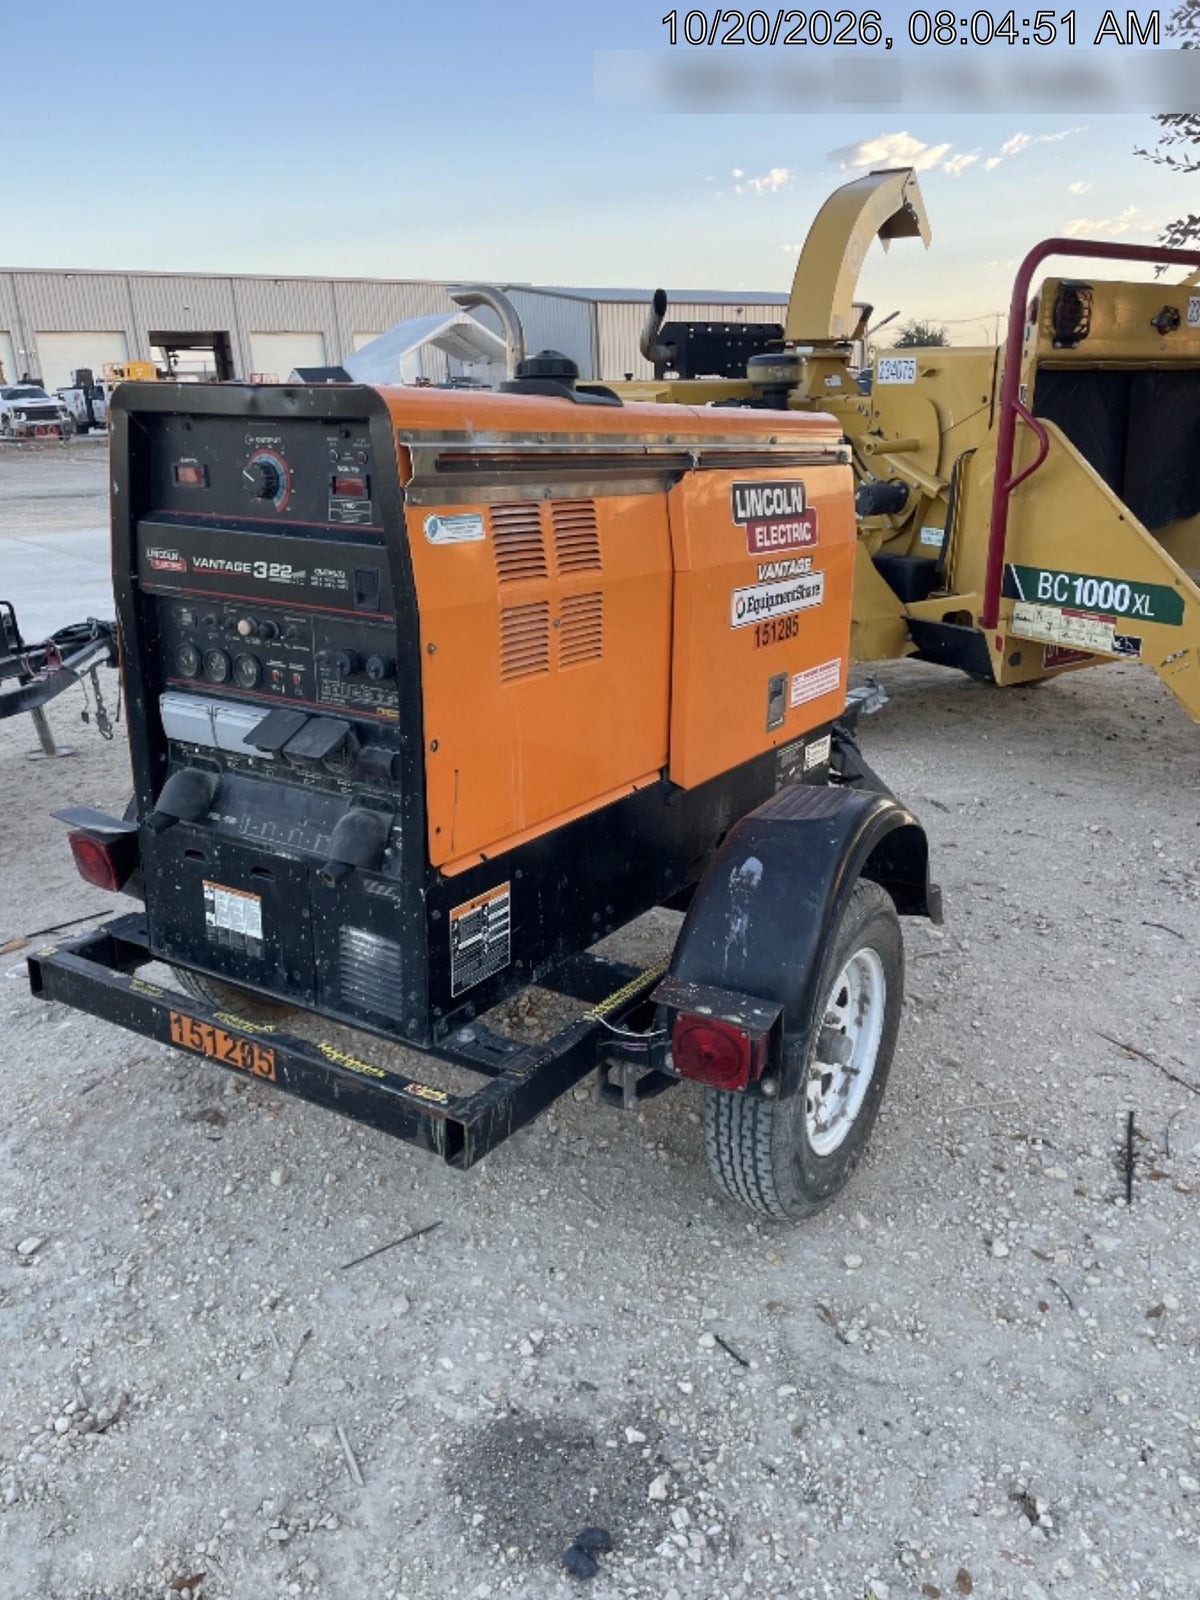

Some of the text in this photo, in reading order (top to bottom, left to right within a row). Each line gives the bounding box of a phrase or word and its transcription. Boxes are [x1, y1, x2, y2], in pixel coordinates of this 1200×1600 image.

[736, 487, 803, 518] LINCOLN
[755, 522, 812, 548] ELECTRIC
[192, 556, 252, 573] VANTAGE
[254, 561, 292, 579] 322
[758, 557, 813, 581] VANTAGE
